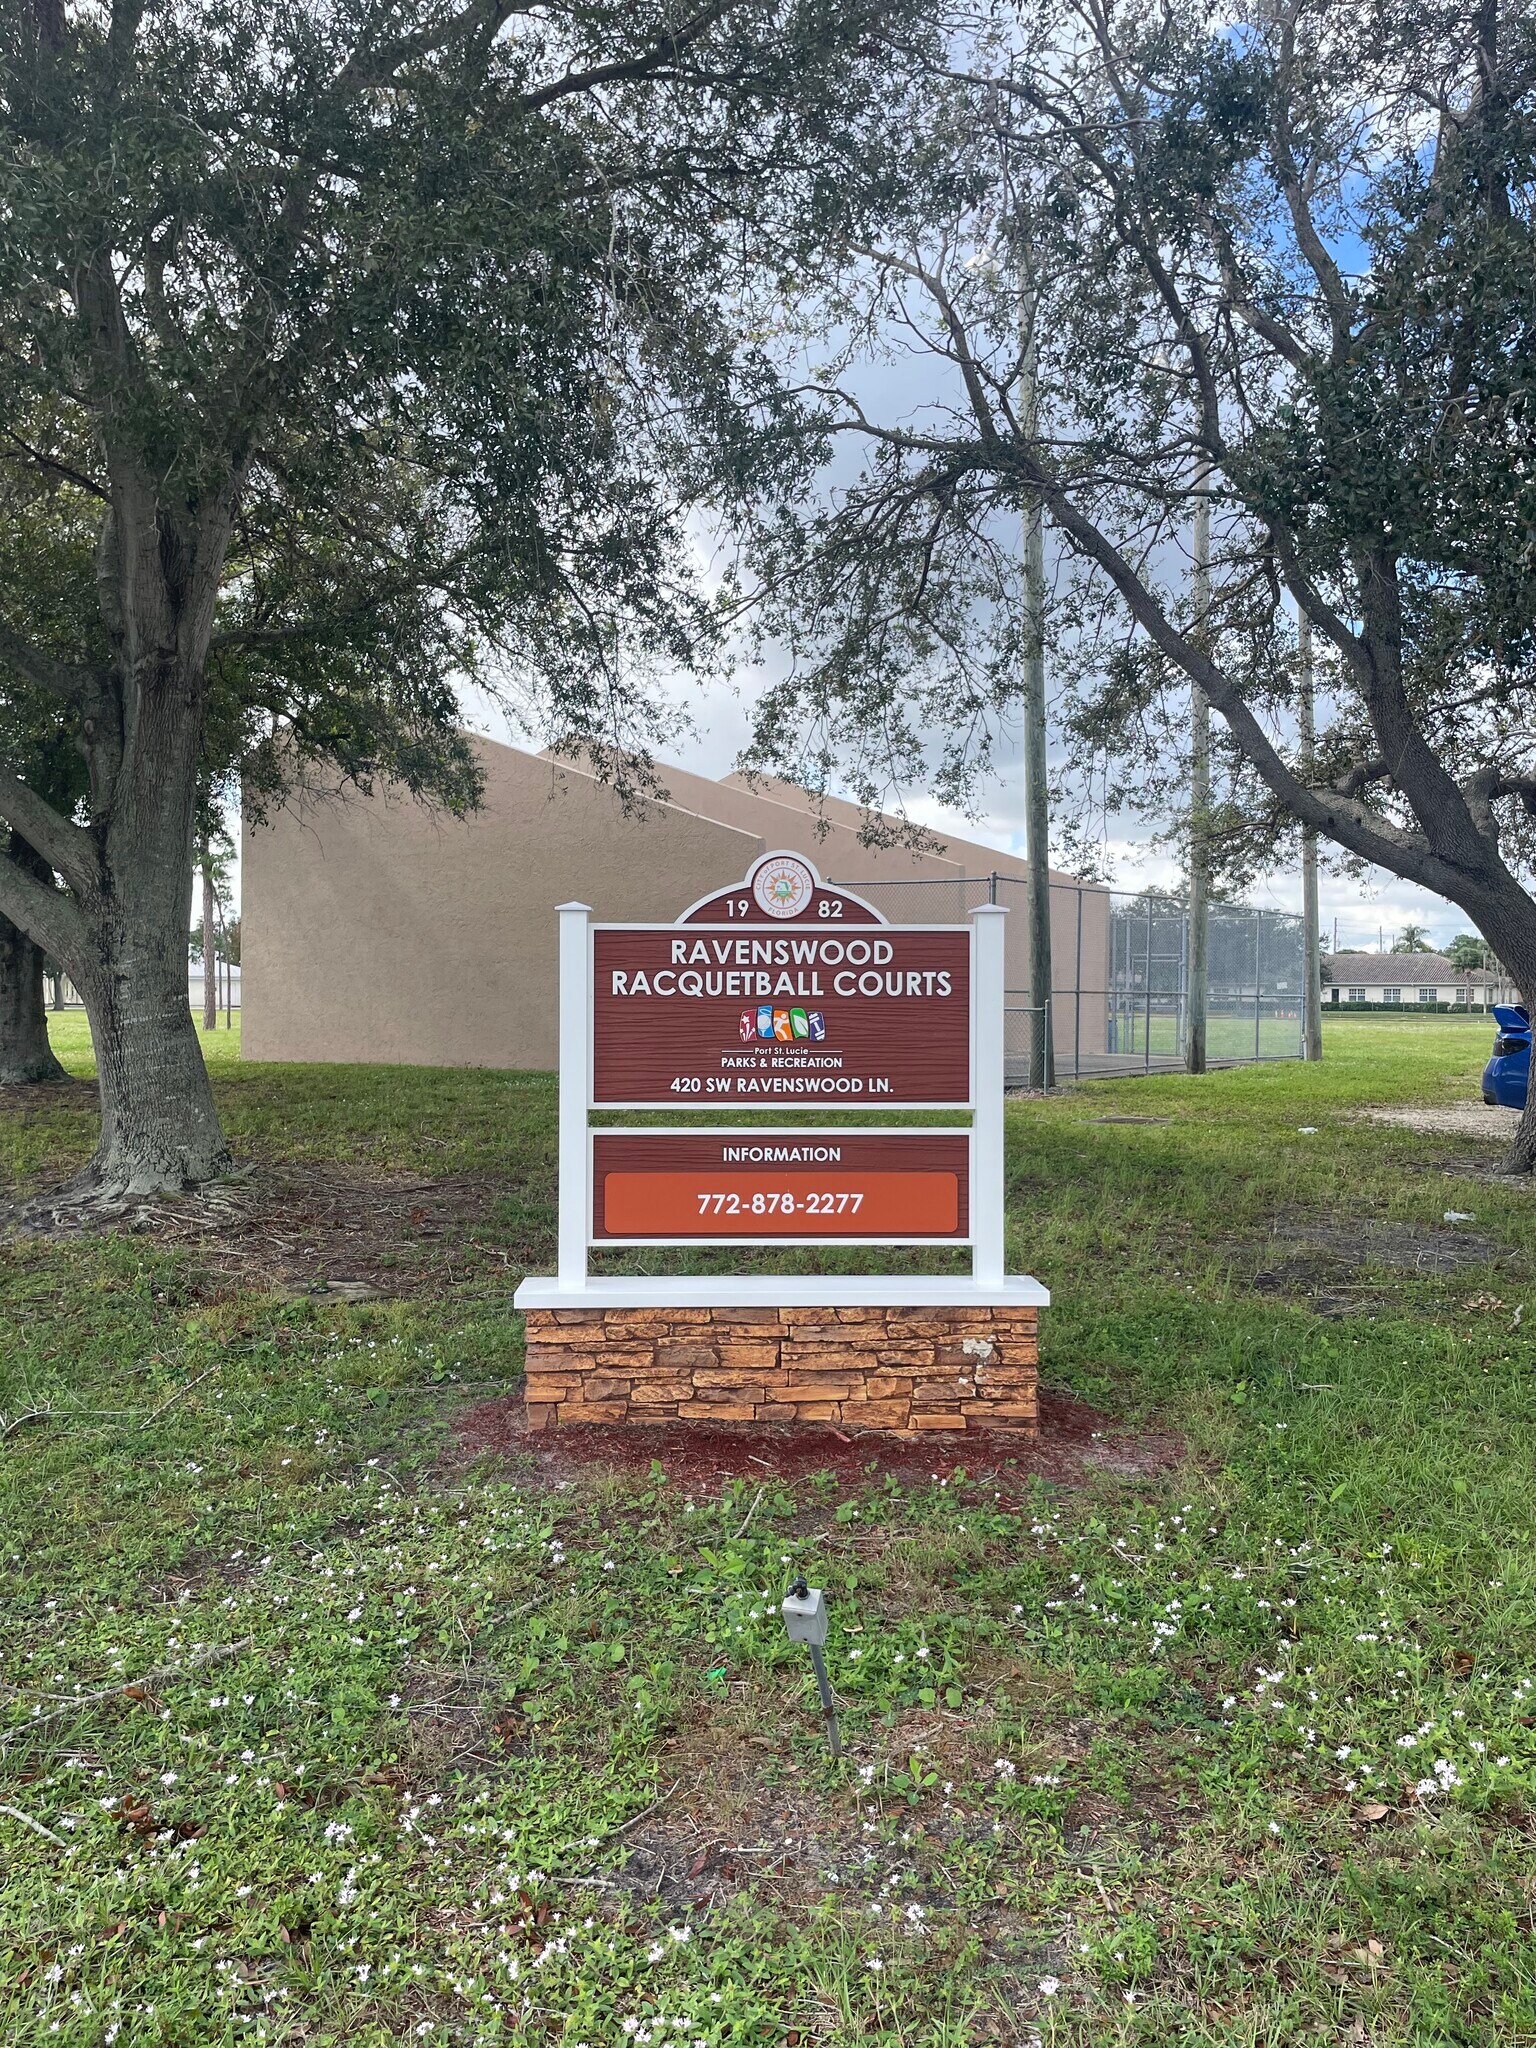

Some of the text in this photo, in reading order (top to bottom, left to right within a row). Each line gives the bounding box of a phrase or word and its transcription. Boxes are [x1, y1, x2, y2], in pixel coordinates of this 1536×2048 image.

[756, 874, 764, 891] CITY
[770, 861, 789, 869] PORT
[800, 870, 811, 889] LUCIE
[726, 899, 749, 918] 19
[767, 907, 799, 916] FLORIDA
[818, 900, 843, 918] 82
[671, 940, 894, 965] RAVENSWOOD
[612, 970, 952, 998] RACQUETBALL COURTS
[754, 1046, 809, 1055] Port St. Lucie
[721, 1057, 843, 1068] PARKS & RECREATION
[670, 1077, 894, 1093] 420 SW RAVENSWOOD LN.
[723, 1147, 841, 1162] INFORMATION
[697, 1192, 864, 1215] 772-878-2277
